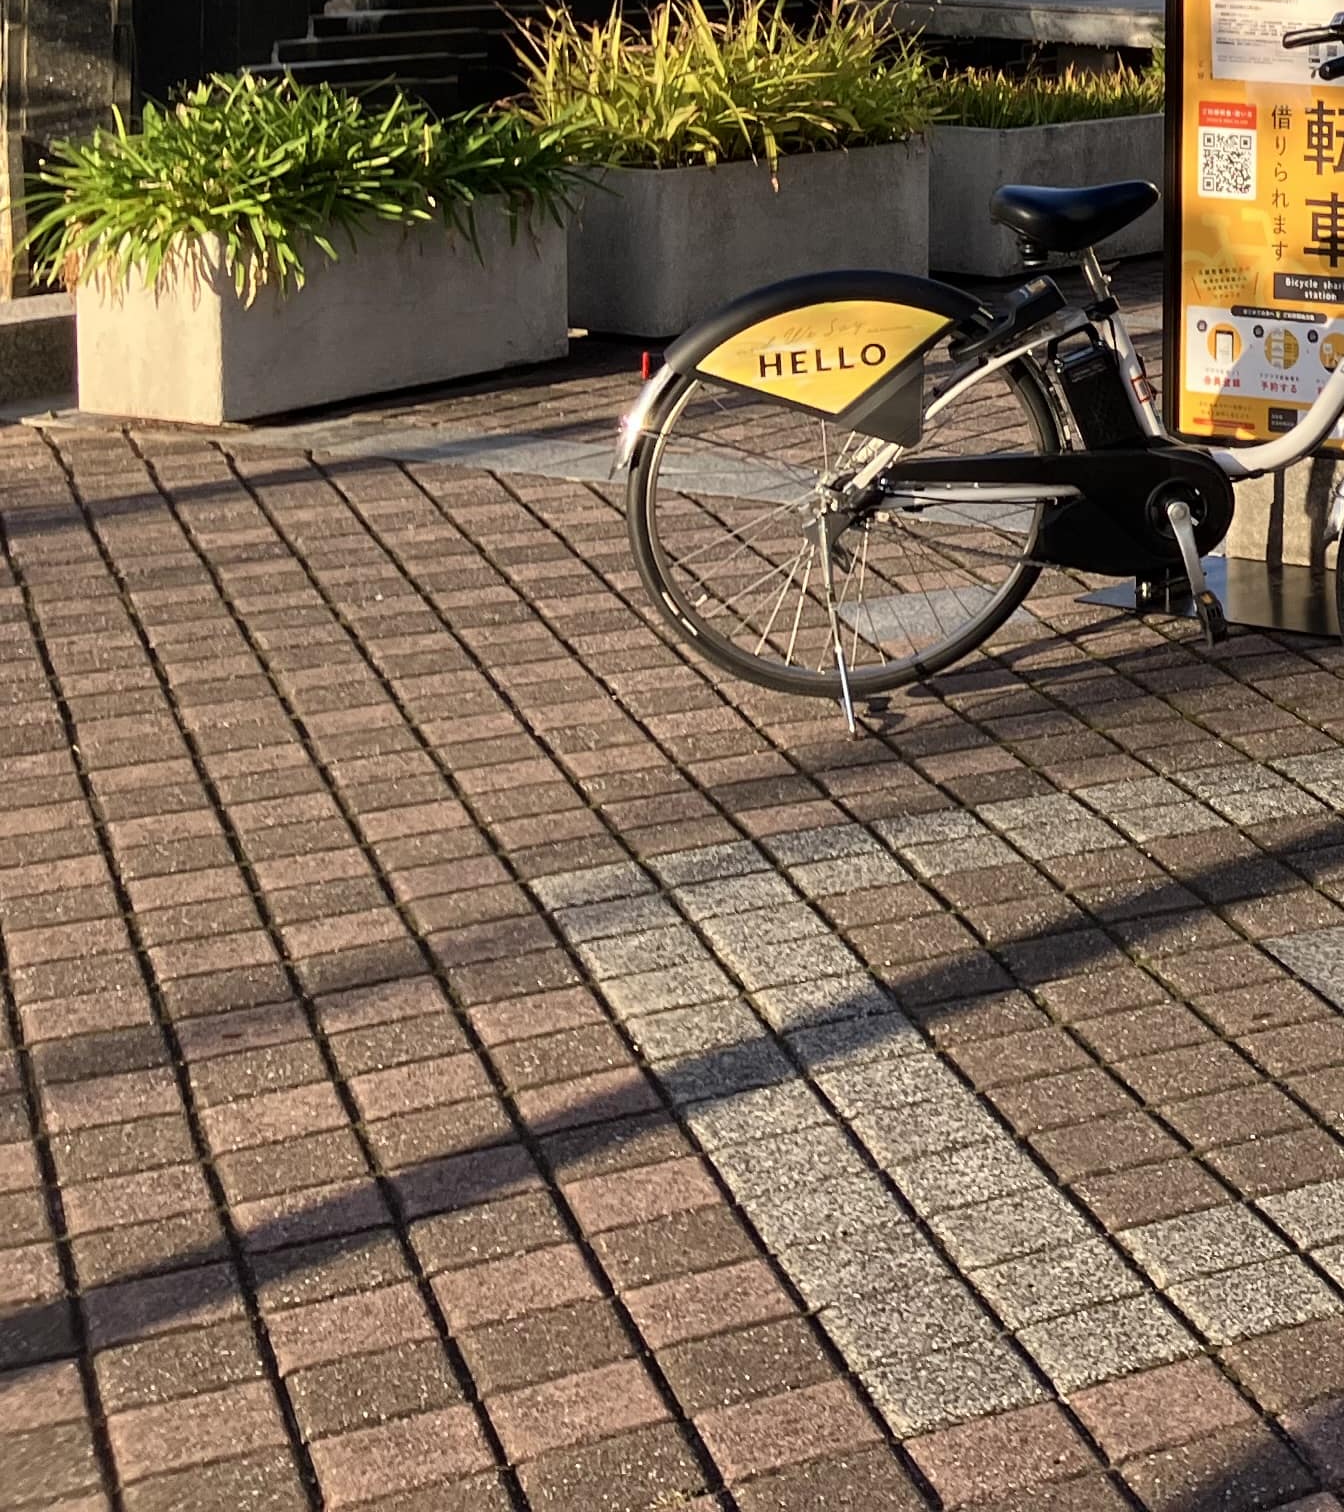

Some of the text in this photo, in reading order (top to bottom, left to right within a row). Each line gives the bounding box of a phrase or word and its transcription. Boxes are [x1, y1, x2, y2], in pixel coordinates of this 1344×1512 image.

[1272, 105, 1292, 261] 借りられます
[1285, 277, 1318, 289] Bicycle
[1304, 291, 1337, 301] station
[759, 343, 887, 378] HELLO
[1261, 380, 1297, 394] 予約する
